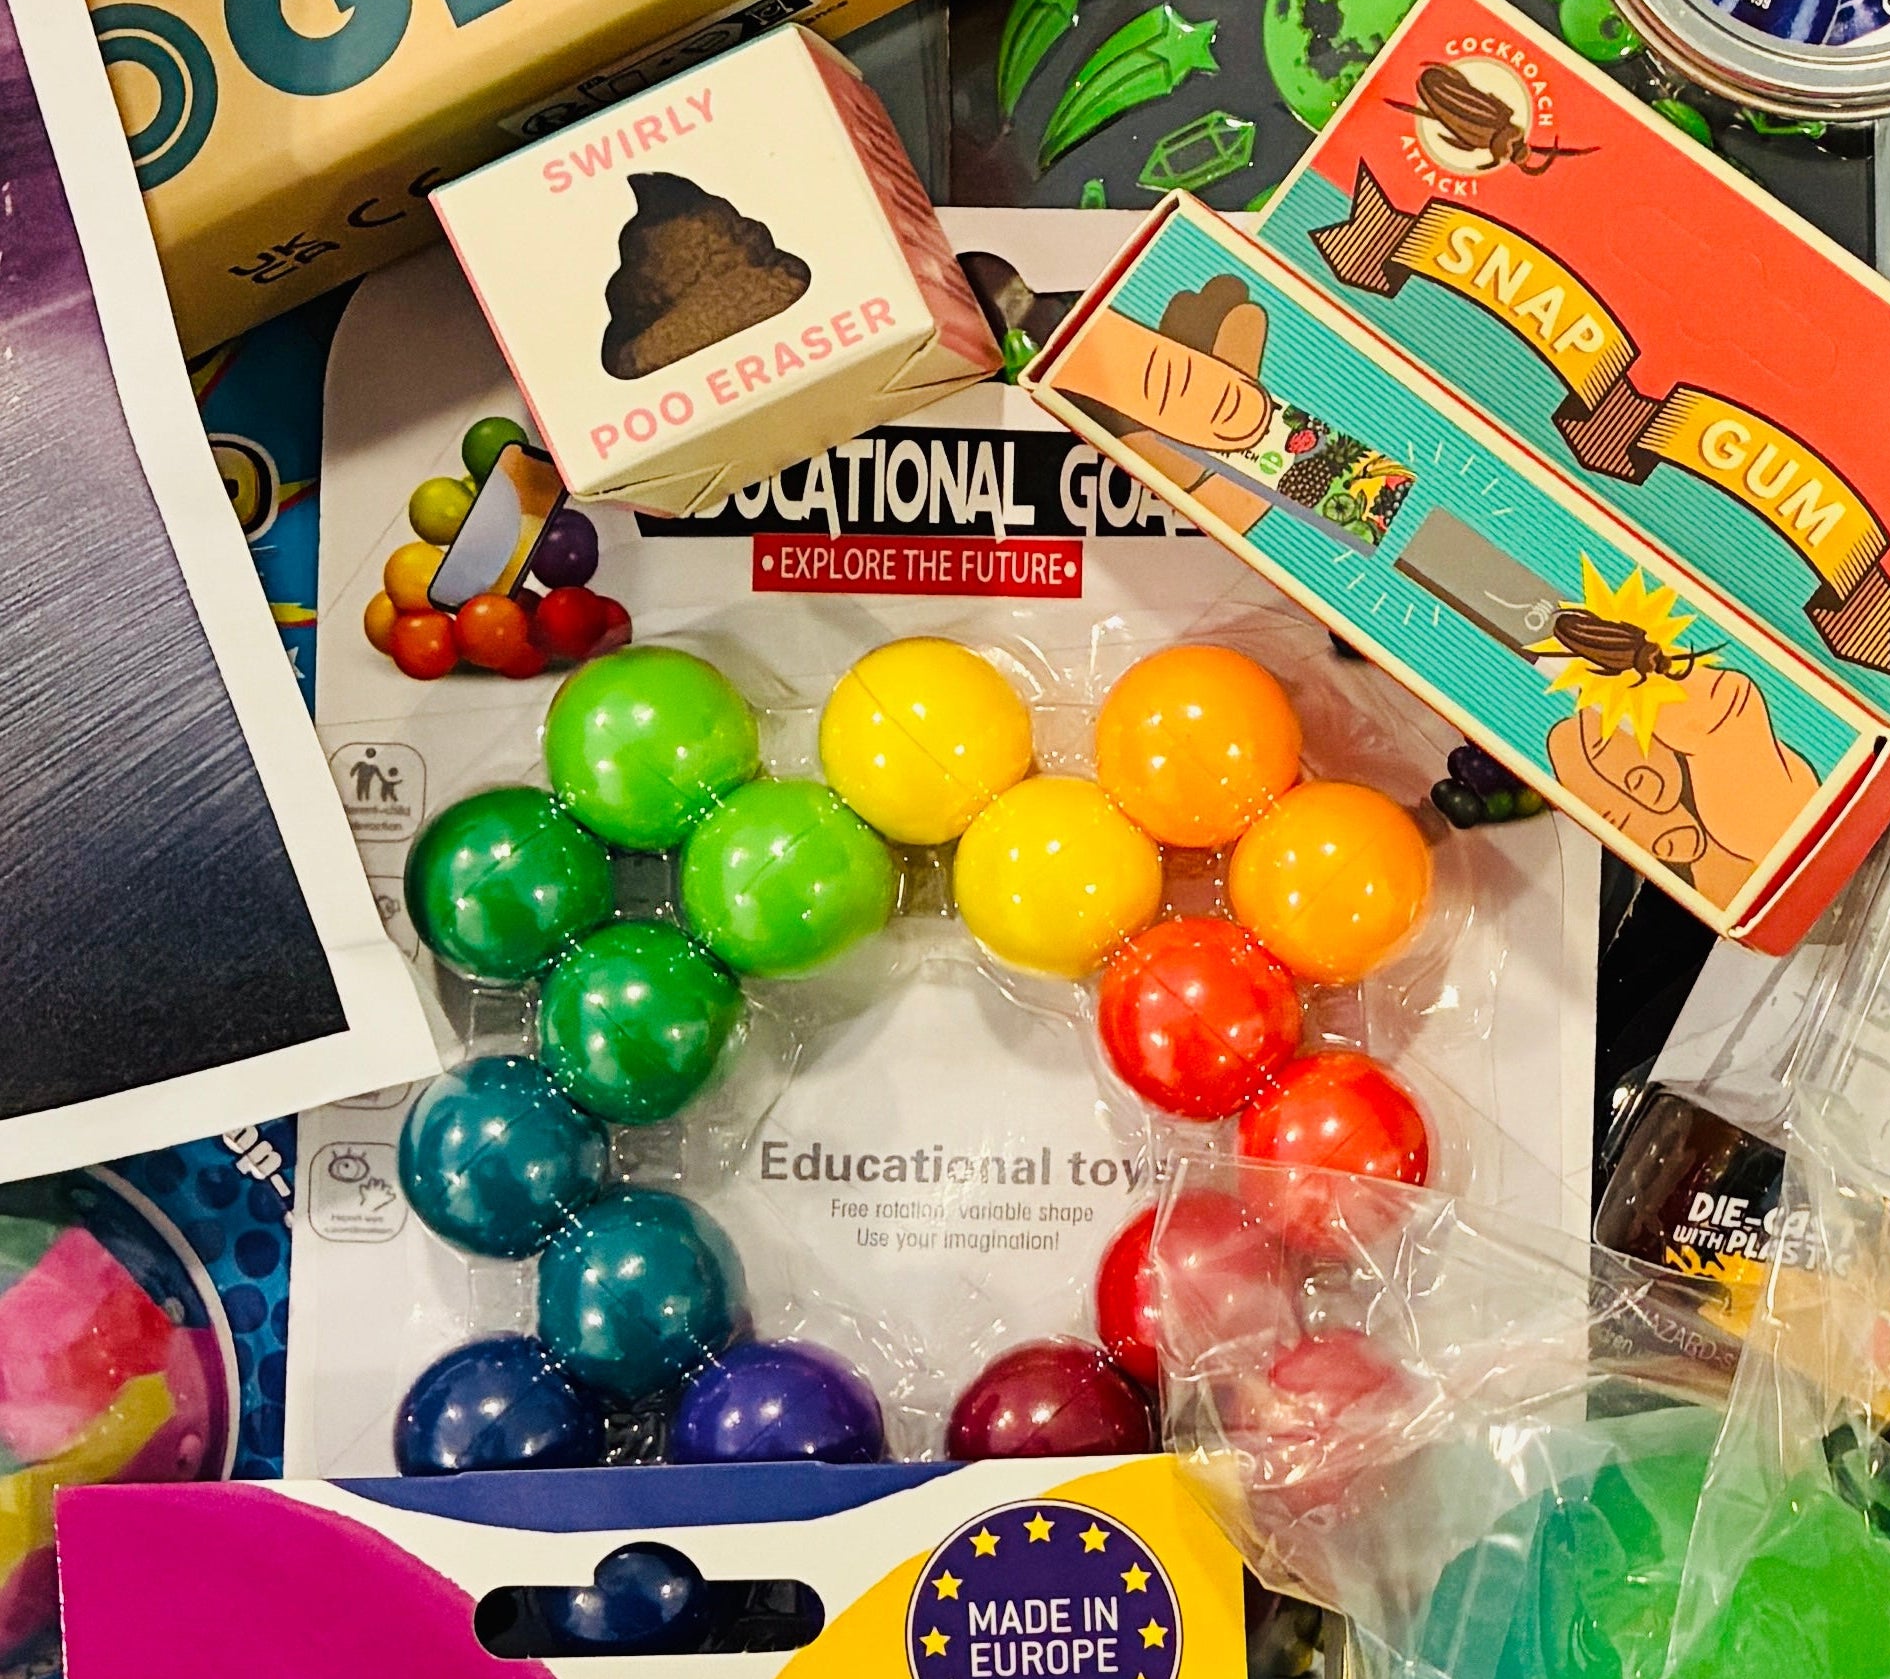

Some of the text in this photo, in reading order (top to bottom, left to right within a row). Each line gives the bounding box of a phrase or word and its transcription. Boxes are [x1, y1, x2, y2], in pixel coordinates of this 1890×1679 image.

[1446, 34, 1556, 129] COCKROACH
[540, 89, 717, 194] SWIRLY
[1397, 133, 1480, 198] ATTACK!
[1437, 224, 1608, 370] SNAP
[589, 295, 897, 460] POO ERASER
[695, 439, 1178, 541] UCATIONAL GOA
[1699, 416, 1852, 549] GUM
[780, 547, 1064, 587] EXPLORE THE FUTURE
[761, 1140, 1052, 1186] Educational
[830, 1197, 869, 1219] Free
[958, 1202, 1032, 1223] variable
[1038, 1204, 1094, 1227] shape
[1688, 1191, 1822, 1238] DIE-CA
[857, 1227, 1060, 1254] Use your imagination!
[1673, 1224, 1722, 1251] WITH
[969, 1596, 1120, 1636] MADE IN
[971, 1635, 1119, 1677] EUROPE
